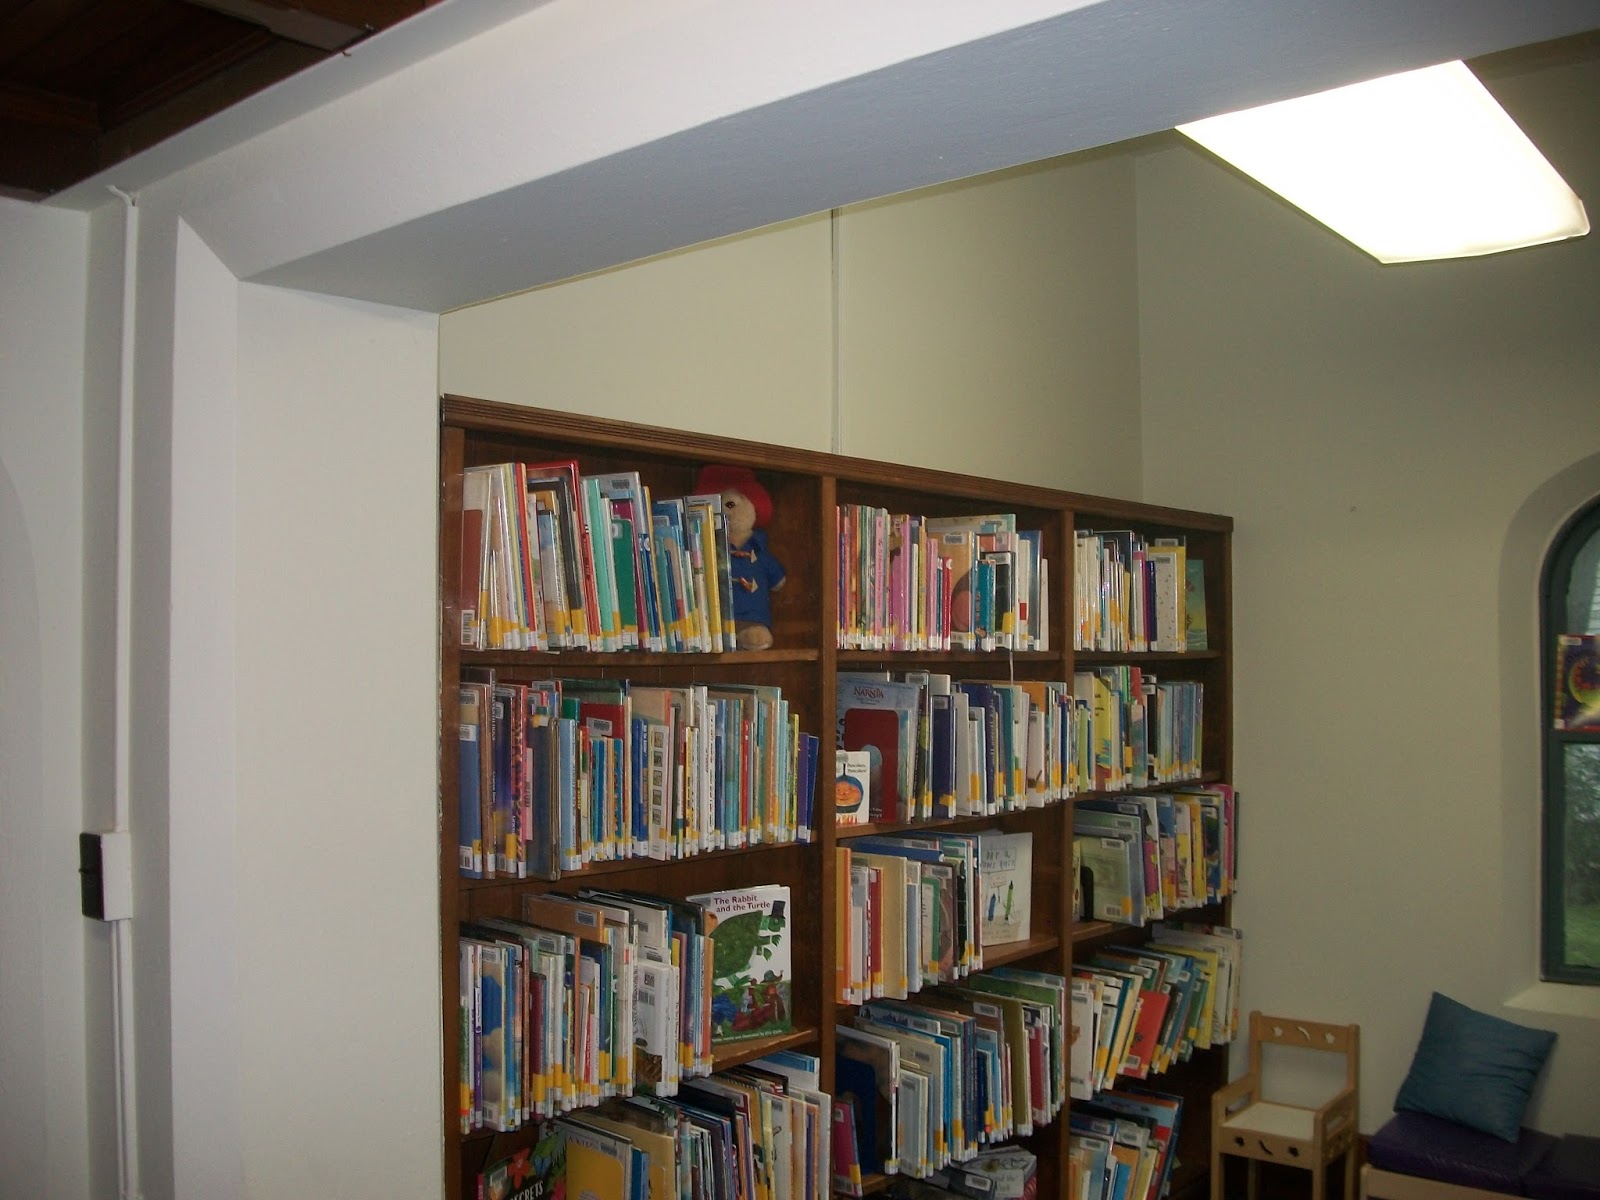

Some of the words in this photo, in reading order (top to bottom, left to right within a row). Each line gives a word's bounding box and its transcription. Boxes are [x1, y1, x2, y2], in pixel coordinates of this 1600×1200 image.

[854, 686, 884, 698] NARNIA
[714, 897, 730, 905] The
[731, 894, 757, 903] Rabbit
[747, 901, 771, 910] Turtle
[510, 1180, 544, 1200] CRETS
